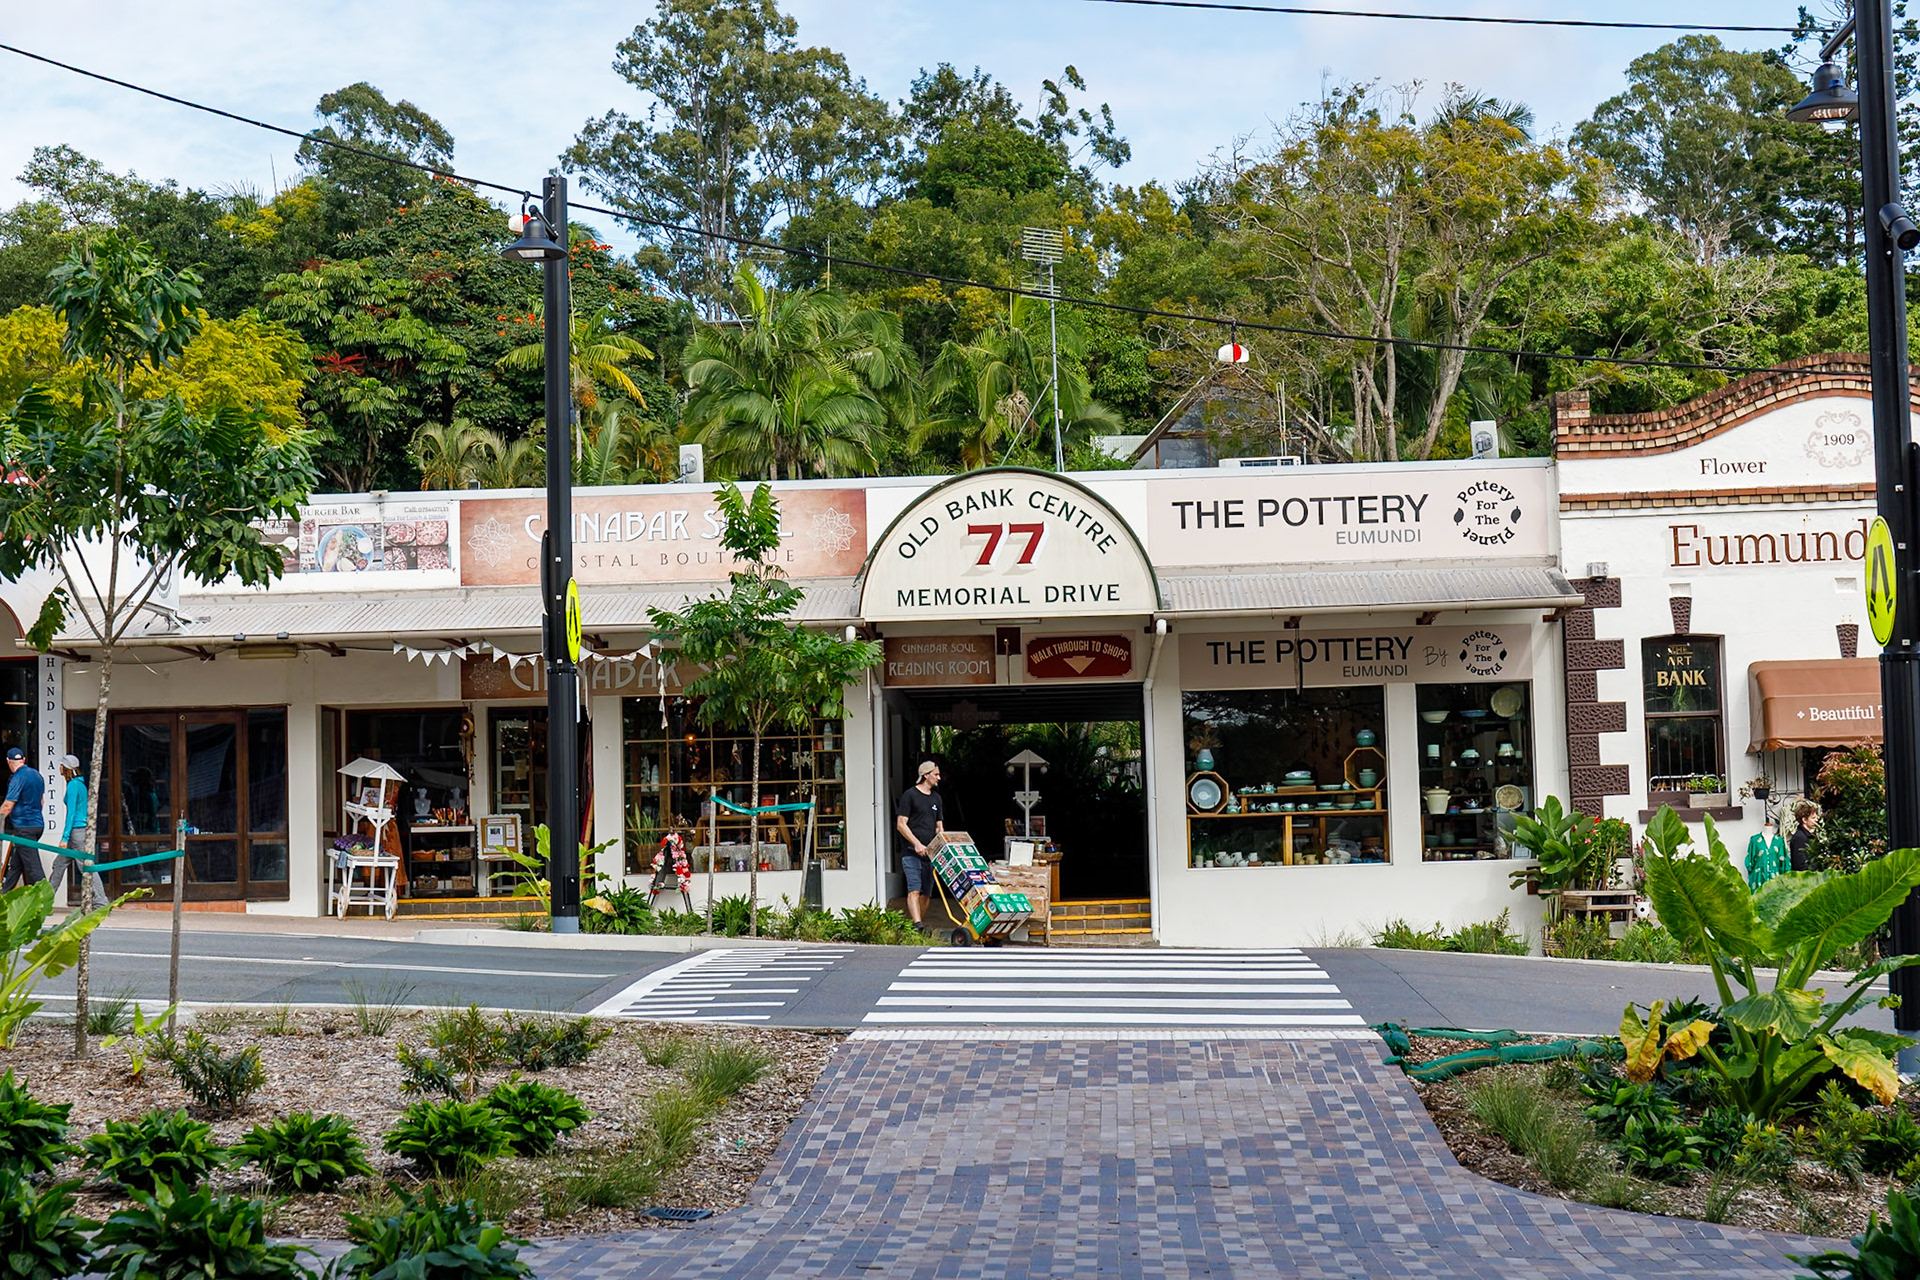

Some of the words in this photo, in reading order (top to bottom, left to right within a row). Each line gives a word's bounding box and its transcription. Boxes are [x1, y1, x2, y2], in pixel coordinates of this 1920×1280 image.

[1823, 434, 1855, 446] 1909
[1700, 458, 1767, 475] Flower
[1456, 480, 1515, 503] Pottery
[300, 506, 338, 516] BURGER
[341, 505, 361, 515] BAR
[1171, 499, 1245, 529] THE
[1258, 493, 1429, 527] POTTERY
[1476, 500, 1497, 511] For
[524, 510, 690, 544] CNABAR
[700, 507, 794, 539] SL
[897, 516, 940, 560] OLD
[945, 487, 1015, 521] BANK
[1028, 490, 1118, 555] CENTRE
[1474, 514, 1500, 525] The
[966, 521, 1048, 566] 77
[1335, 528, 1422, 545] EUMUNDI
[1462, 527, 1515, 547] Planet
[1668, 518, 1867, 568] Eumund
[526, 553, 639, 571] CSTAL
[660, 549, 795, 566] BOUTUE
[897, 585, 1031, 607] MEMORIAL
[1044, 583, 1121, 604] DRIVE
[1462, 629, 1503, 646] Pottery
[901, 644, 948, 654] CINNABAR
[951, 643, 978, 653] SOUL
[1030, 646, 1053, 664] WALK
[1052, 640, 1089, 654] THROUGH
[1090, 641, 1101, 652] TO
[1102, 642, 1129, 662] SHOPS
[1206, 639, 1266, 665] THE
[1276, 635, 1414, 663] POTTERY
[1475, 643, 1490, 652] For
[1423, 645, 1449, 668] By
[1474, 653, 1492, 662] The
[1667, 656, 1693, 666] ART
[889, 661, 945, 676] READING
[949, 660, 991, 675] ROOM
[1342, 664, 1408, 678] EUMUNDI
[1465, 662, 1502, 677] Planet
[1656, 669, 1707, 687] BANK
[1809, 704, 1876, 722] Beautiful
